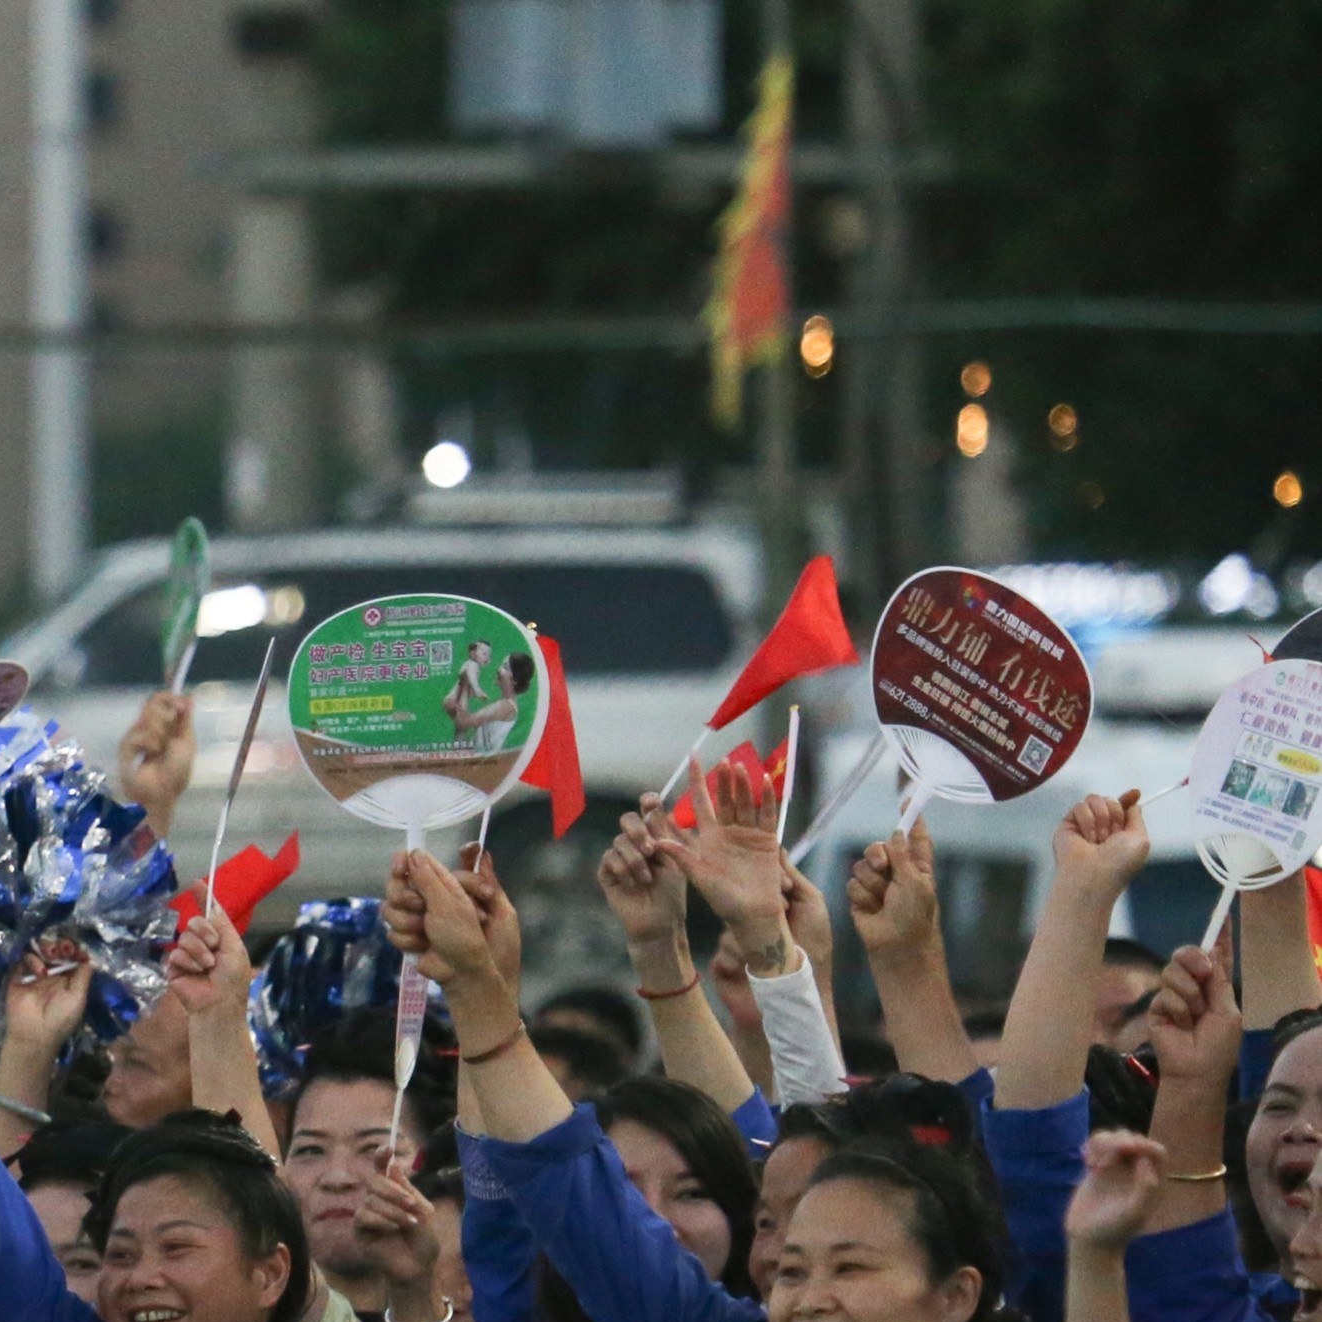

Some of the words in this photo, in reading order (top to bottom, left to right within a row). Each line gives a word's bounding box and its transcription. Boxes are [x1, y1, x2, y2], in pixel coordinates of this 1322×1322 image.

[309, 642, 366, 664] 做产检
[371, 639, 428, 661] 生宝宝
[309, 663, 430, 685] 妇产医院更专业
